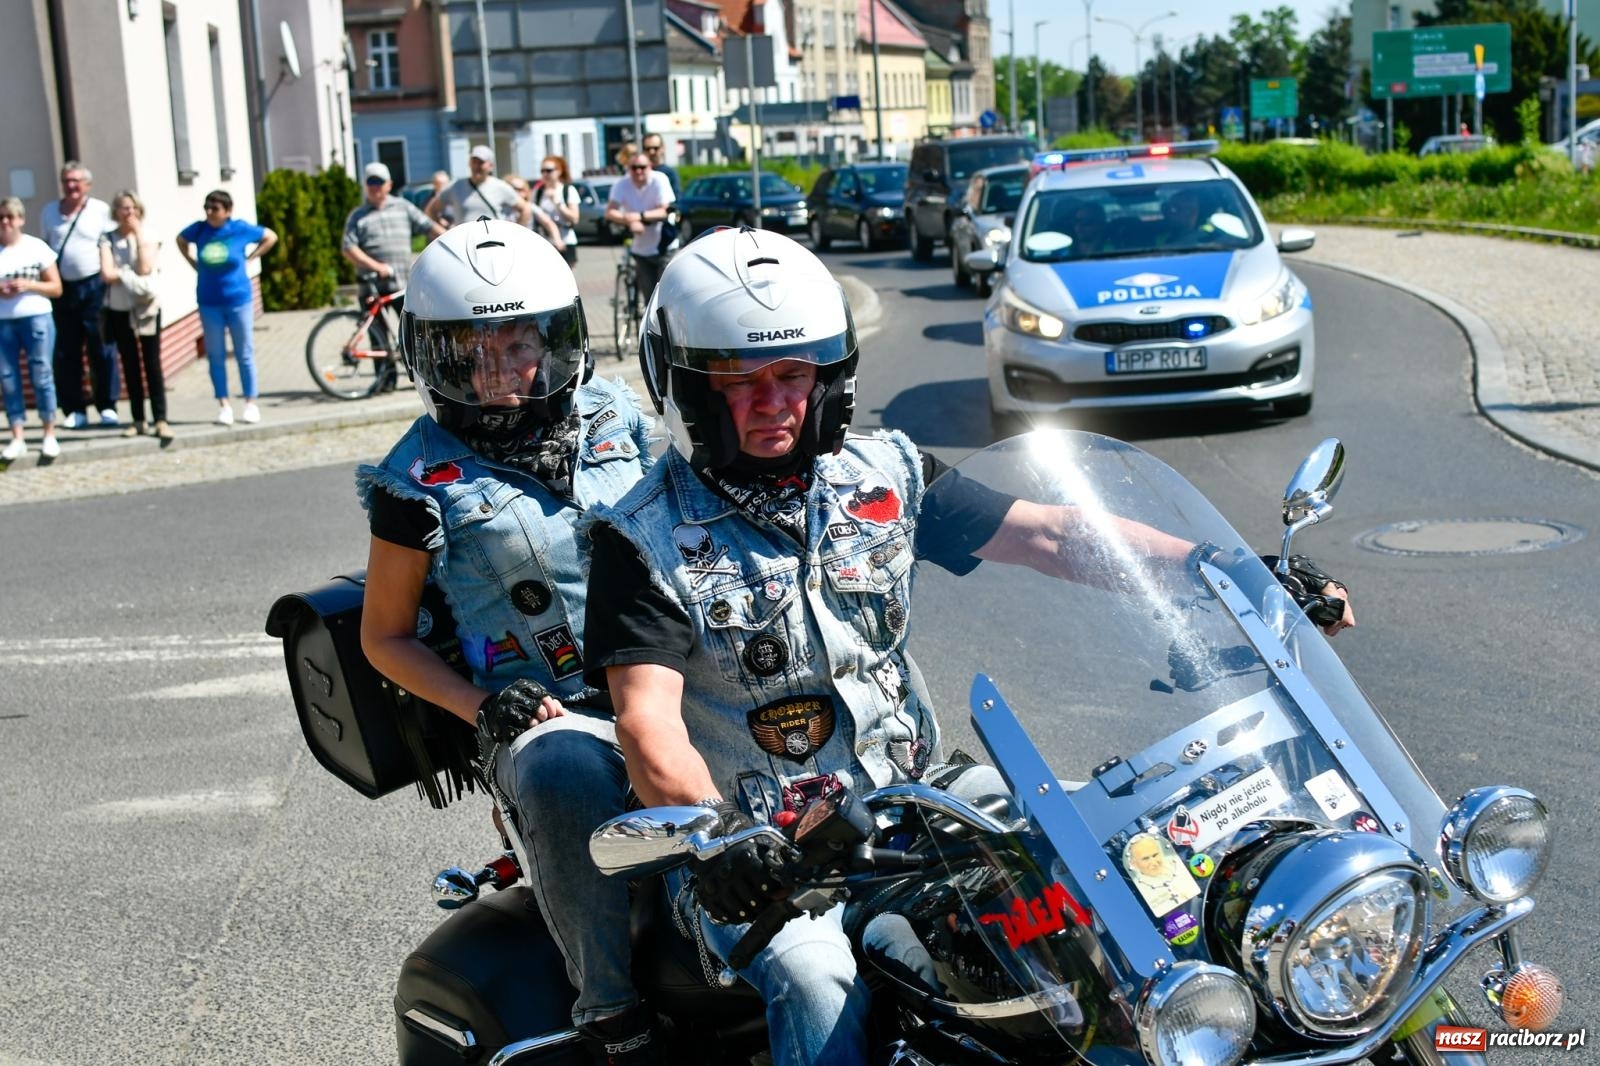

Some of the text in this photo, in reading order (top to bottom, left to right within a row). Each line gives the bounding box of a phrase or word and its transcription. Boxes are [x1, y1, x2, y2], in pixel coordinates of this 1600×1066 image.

[1097, 285, 1202, 304] POLICJA
[472, 300, 525, 315] SHARK
[747, 327, 806, 342] SHARK
[1117, 347, 1204, 370] HPP R014
[780, 718, 807, 729] RIDER
[1200, 778, 1272, 822] Nigdy nie jeżdżę
[1216, 795, 1268, 830] po alkoholu
